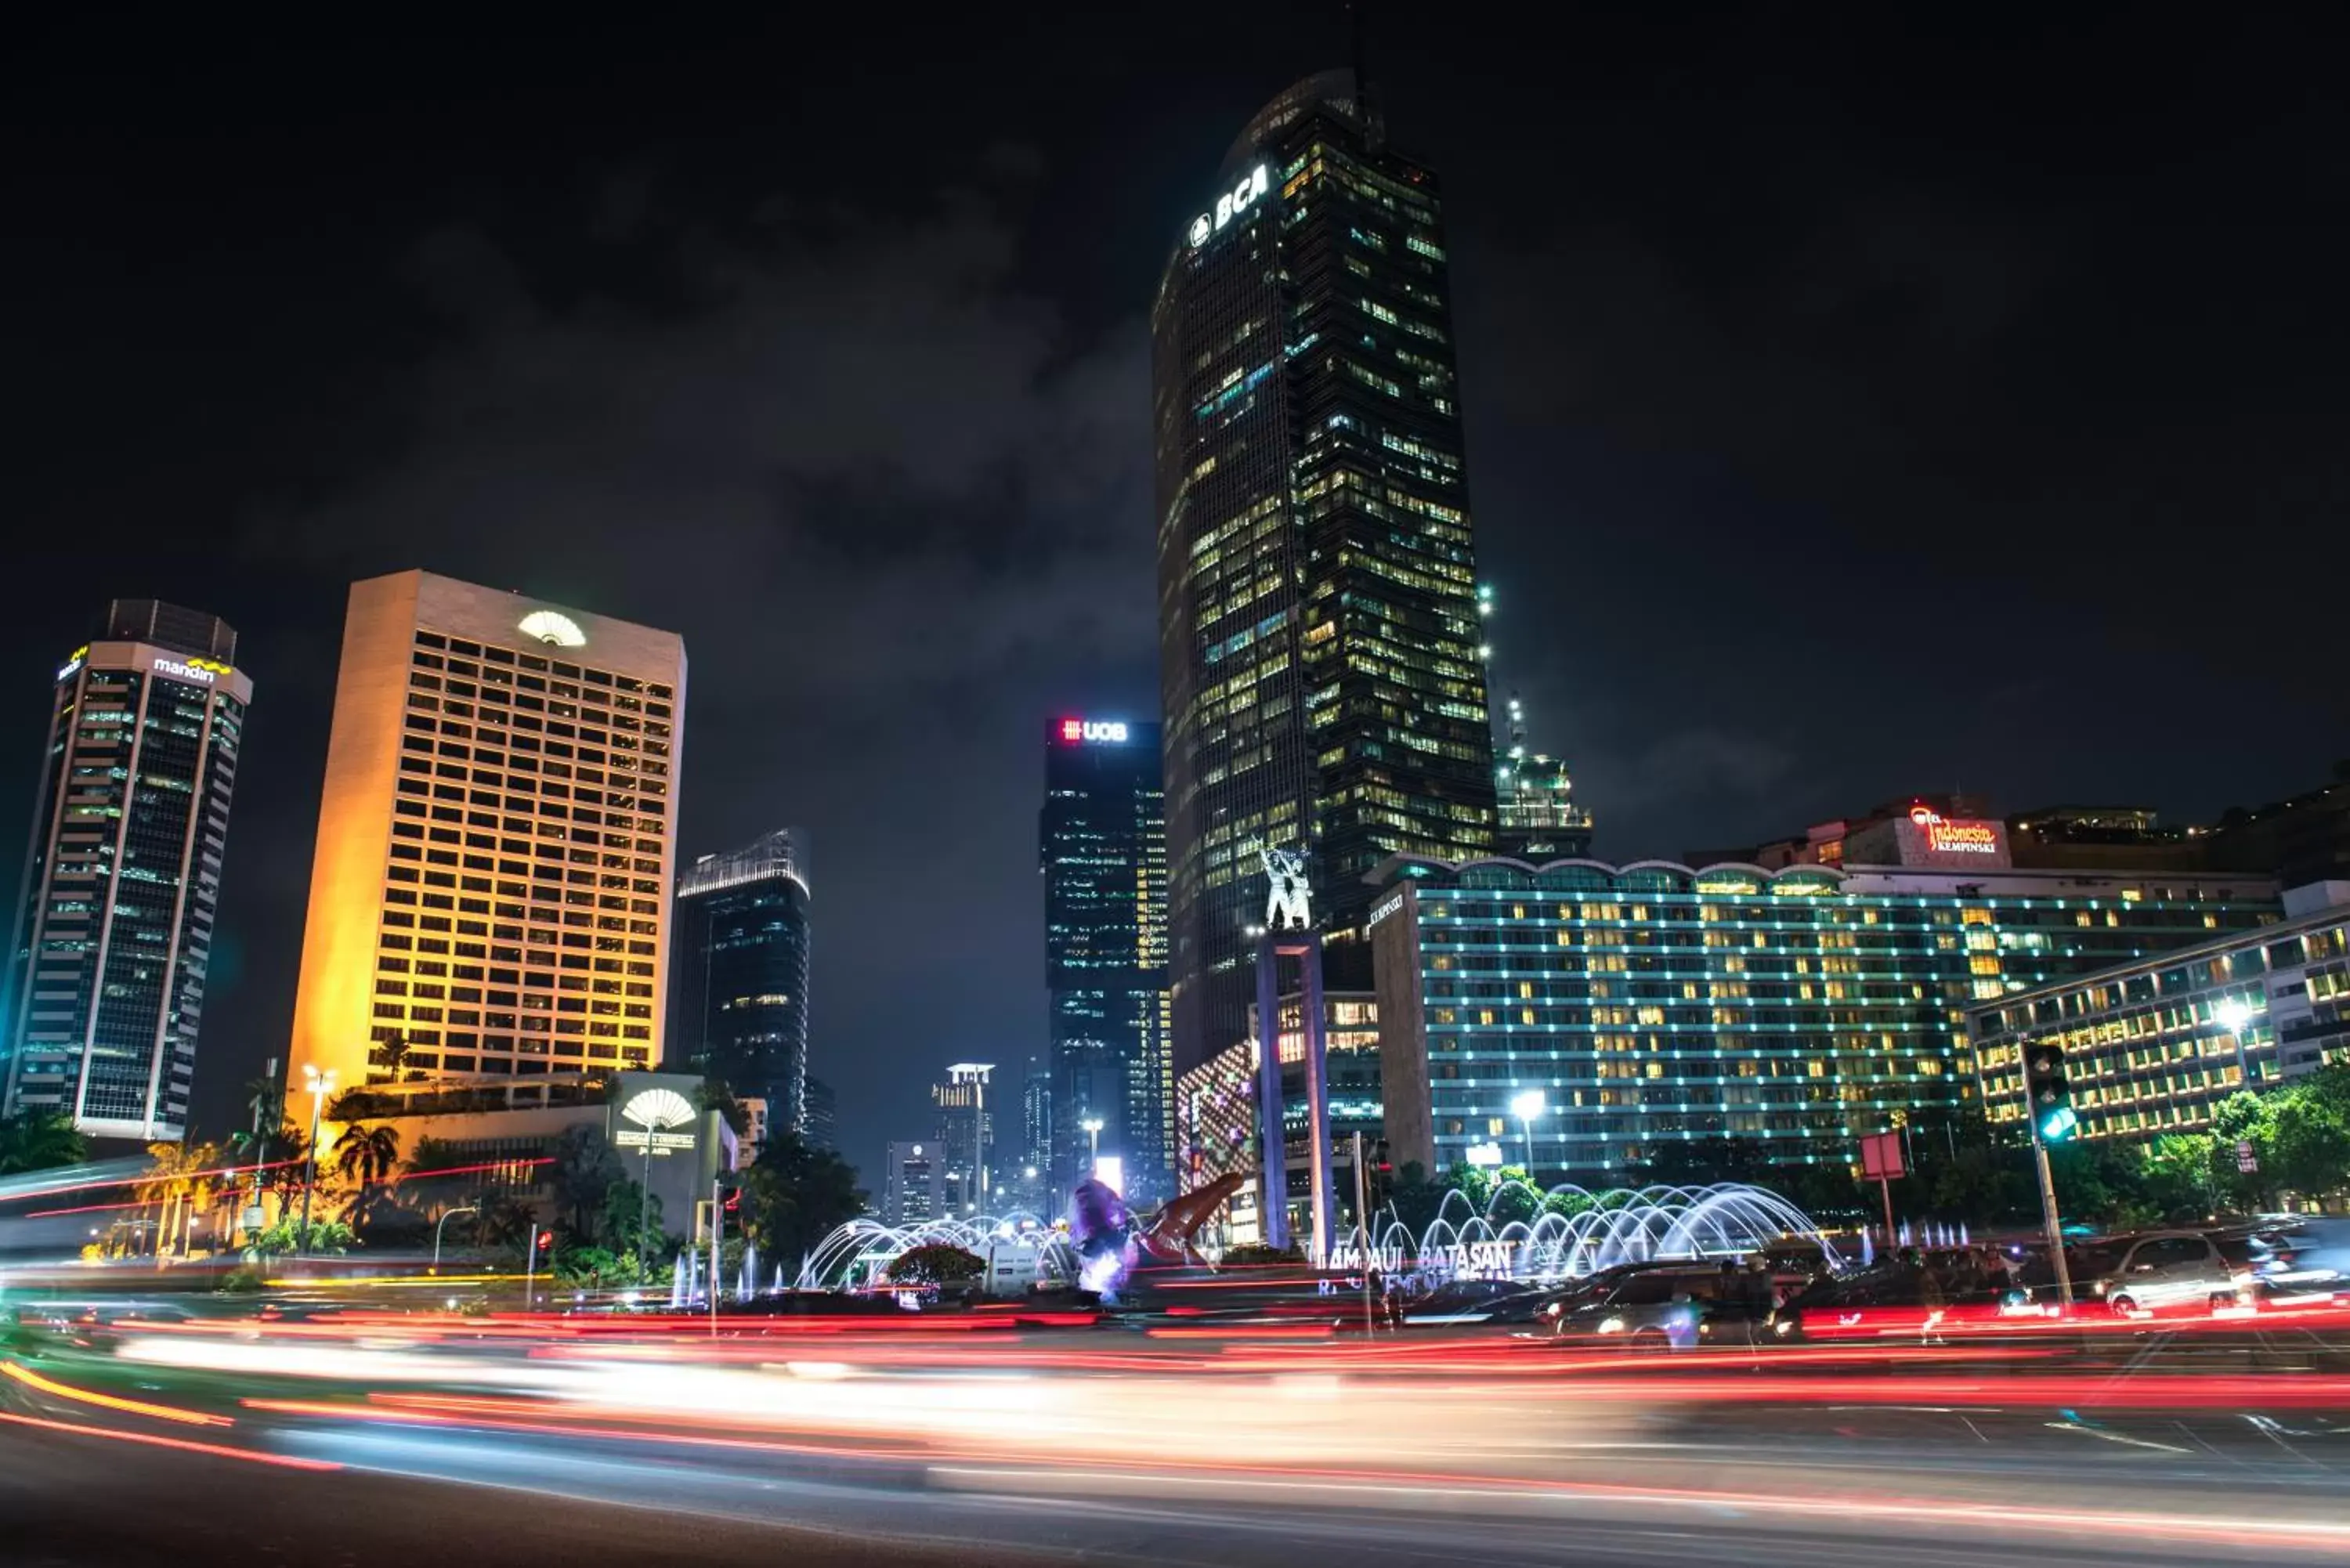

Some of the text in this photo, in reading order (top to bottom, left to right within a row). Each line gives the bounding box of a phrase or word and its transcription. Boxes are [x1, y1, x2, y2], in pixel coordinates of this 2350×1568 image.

[1216, 164, 1267, 230] BCA
[1083, 722, 1127, 741] UOB
[1911, 807, 1996, 852] Indonesia
[1938, 840, 1996, 853] KEMPINSKI
[638, 1146, 671, 1155] JAARTA
[1419, 1244, 1512, 1270] BATASAN
